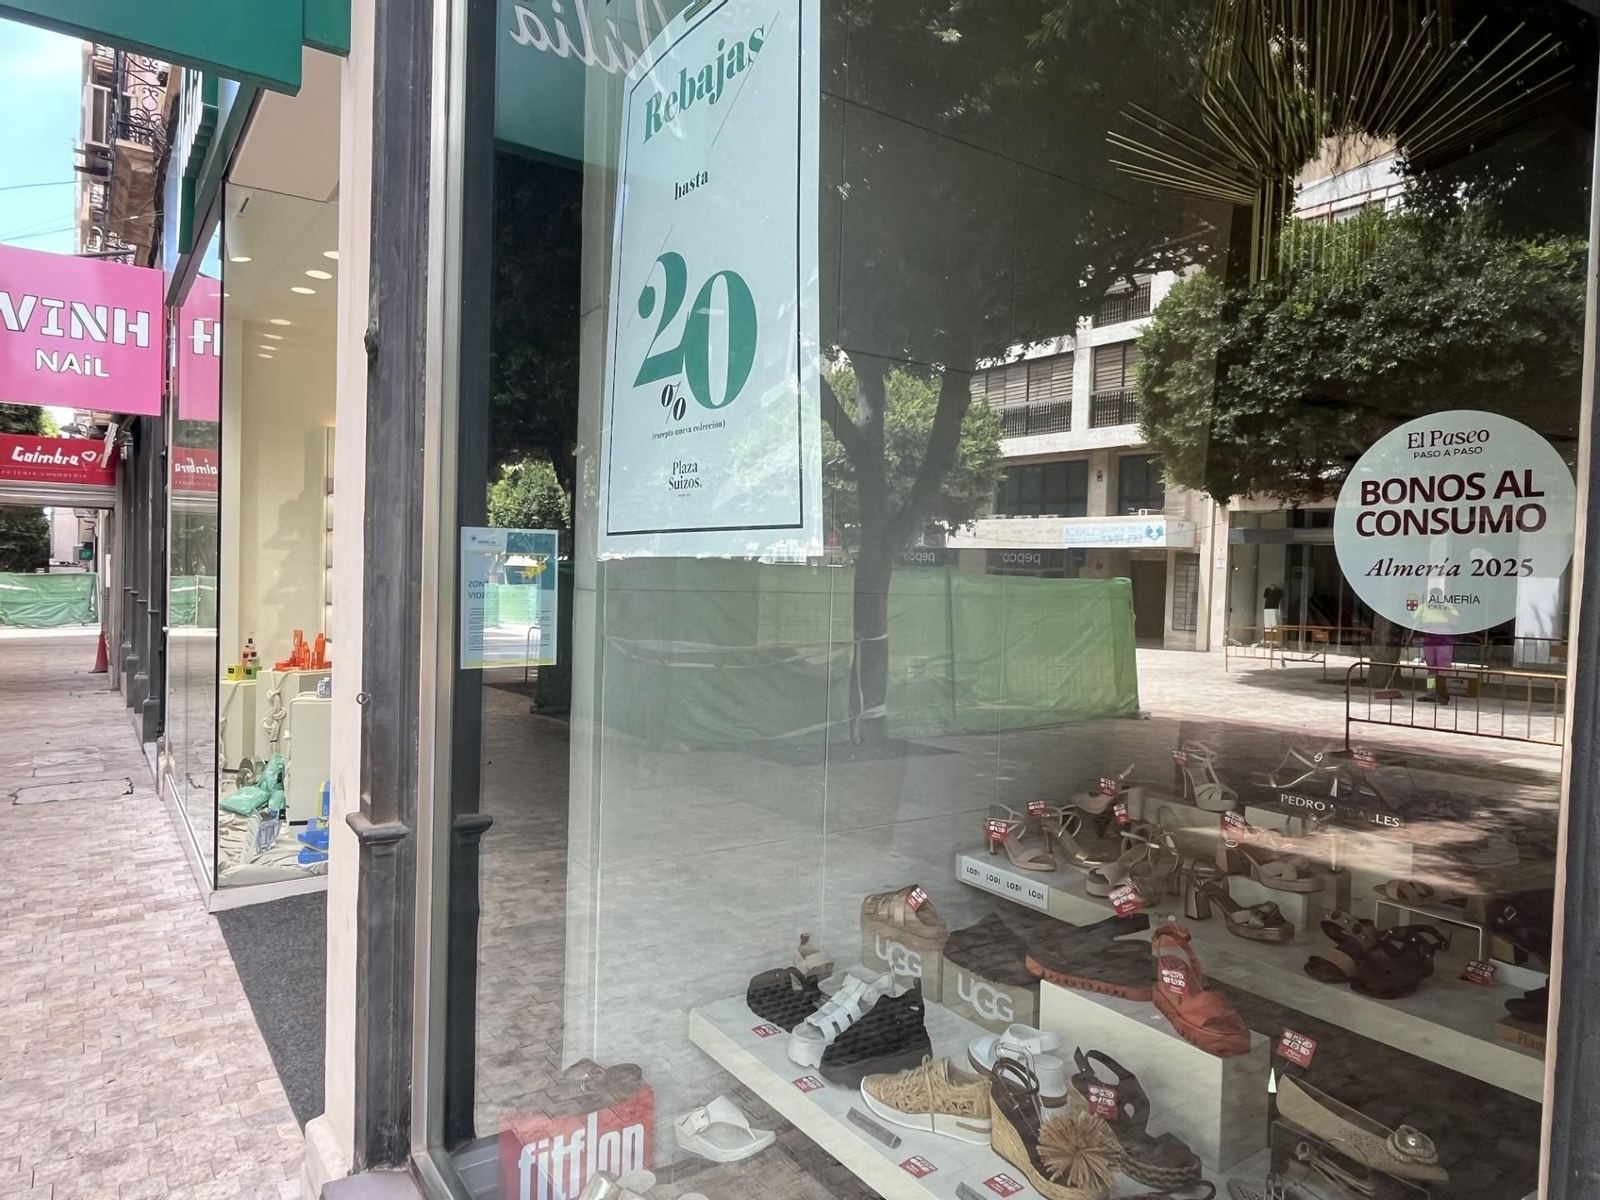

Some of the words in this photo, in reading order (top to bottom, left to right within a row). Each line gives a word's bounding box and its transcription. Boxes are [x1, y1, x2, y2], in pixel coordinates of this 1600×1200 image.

[643, 24, 765, 145] Rebajas
[674, 168, 709, 200] hasta
[0, 290, 150, 348] VINH
[632, 251, 758, 409] 20
[661, 380, 687, 424] %
[11, 445, 79, 466] Coimbra
[1406, 432, 1425, 449] El
[1429, 429, 1490, 447] Paseo
[1413, 450, 1441, 459] PASO
[1443, 449, 1451, 457] A
[1453, 446, 1483, 455] PASO
[668, 475, 702, 491] Suizos.
[672, 460, 698, 475] Plaza
[1360, 472, 1486, 506] BONOS
[1493, 469, 1545, 499] AL
[1355, 502, 1547, 537] CONSUMO
[1364, 557, 1461, 577] Almería
[1470, 558, 1534, 578] 2025
[1429, 593, 1480, 604] ALMERÍA
[1280, 793, 1326, 811] PEDRO
[966, 866, 980, 875] LODI
[986, 873, 1000, 884] LODI
[1006, 881, 1022, 892] LODI
[1028, 889, 1044, 900] LODI
[875, 934, 922, 977] UGG
[957, 972, 1014, 1022] UGG
